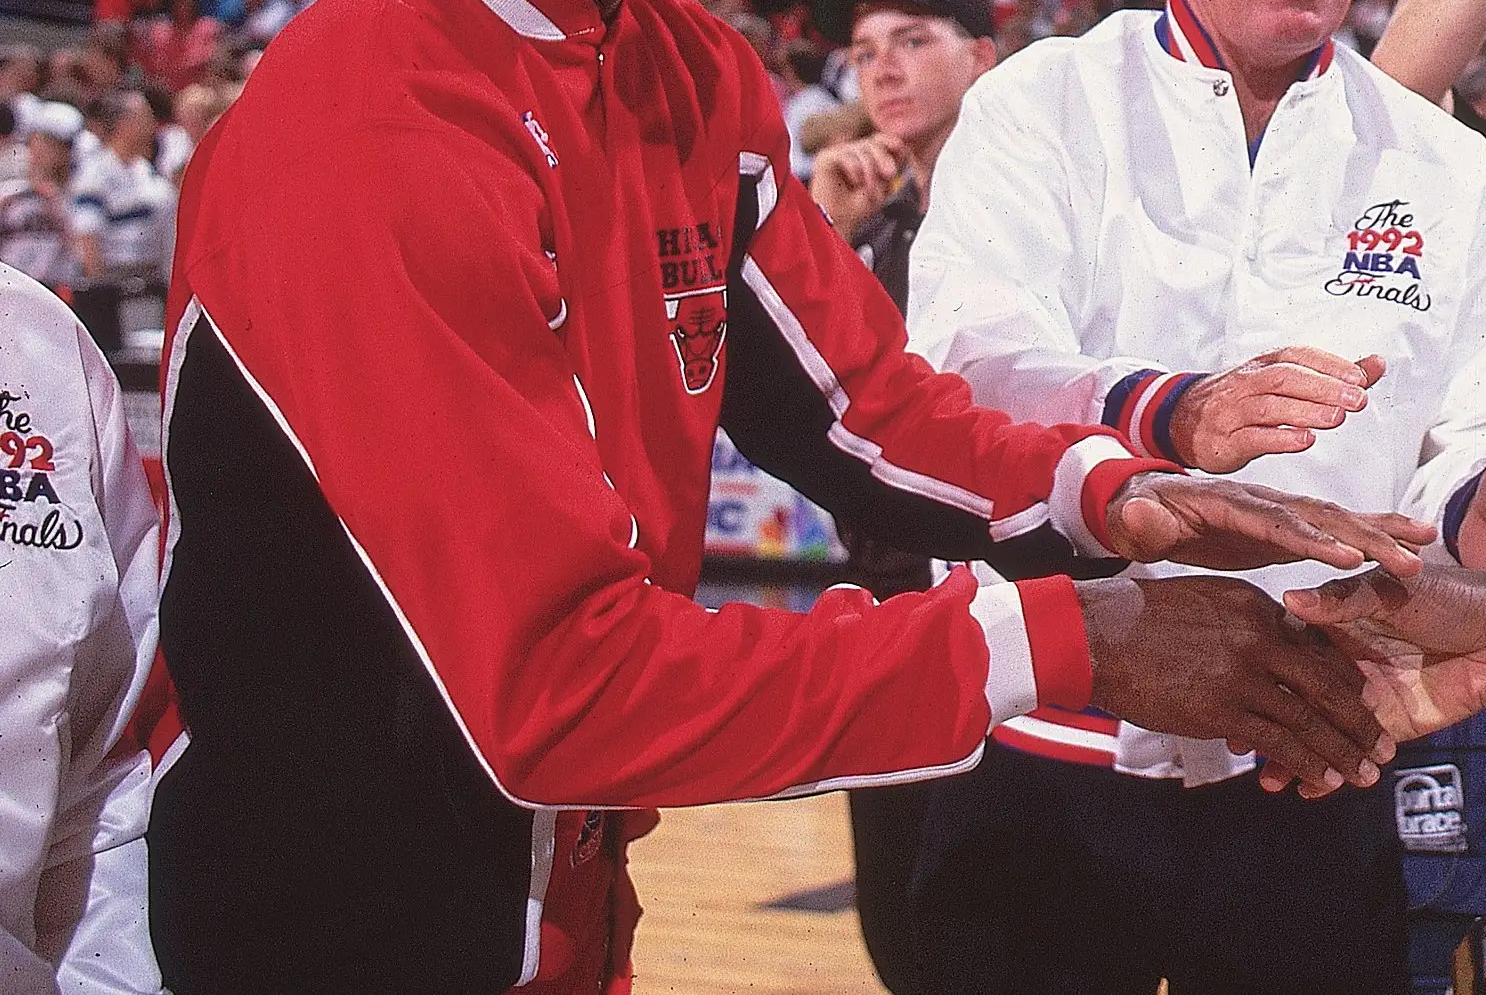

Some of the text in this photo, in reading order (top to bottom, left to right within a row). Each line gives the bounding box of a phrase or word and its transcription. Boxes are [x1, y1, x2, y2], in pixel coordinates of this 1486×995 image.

[1355, 199, 1413, 231] The
[1347, 227, 1424, 257] 1992
[1343, 252, 1421, 280] NBA
[1324, 270, 1431, 311] Finals
[0, 431, 56, 472] 92
[0, 469, 62, 504] BA
[0, 502, 83, 550] nals
